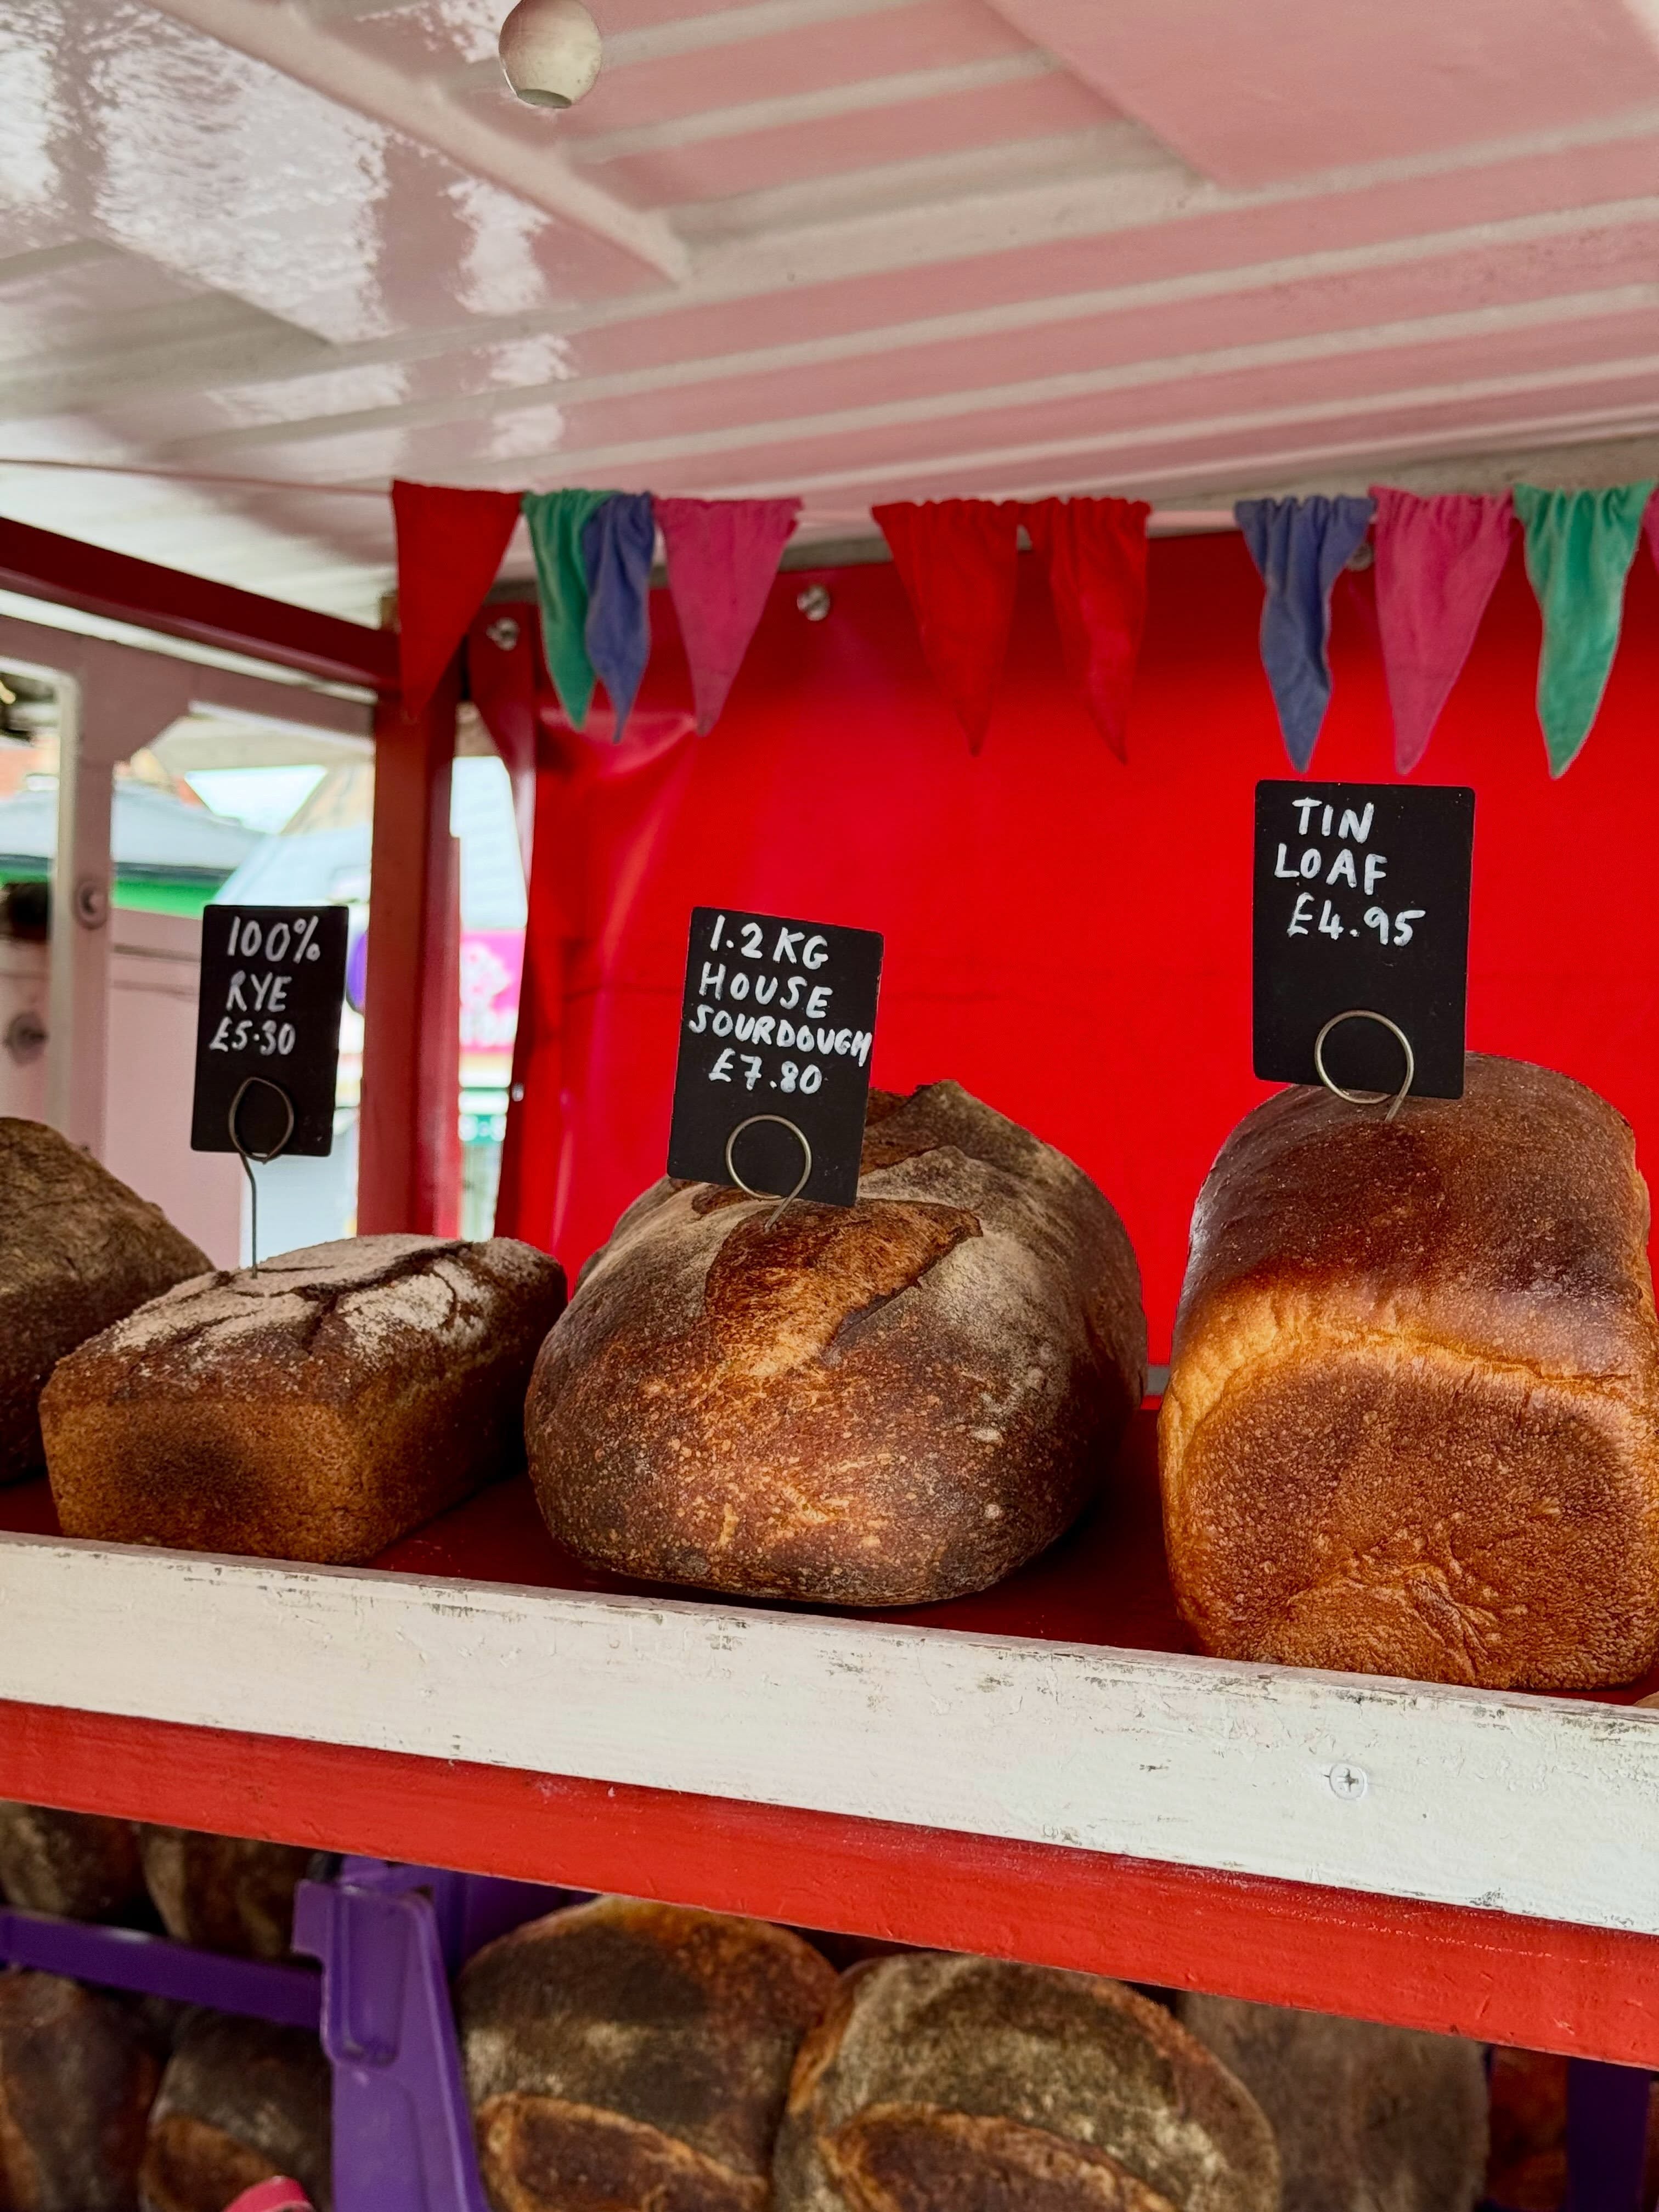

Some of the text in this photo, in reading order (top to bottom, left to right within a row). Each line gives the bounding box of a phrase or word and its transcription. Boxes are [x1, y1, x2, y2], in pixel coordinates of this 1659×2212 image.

[1291, 797, 1374, 843] TIN
[1274, 843, 1388, 895] LOAF
[227, 915, 321, 964] 100%
[1286, 892, 1426, 946] £4.95
[226, 970, 292, 1012] RYE
[698, 961, 833, 1019] HOUSE
[689, 1004, 872, 1067] SOURDOUGH
[708, 1048, 822, 1094] £7.80
